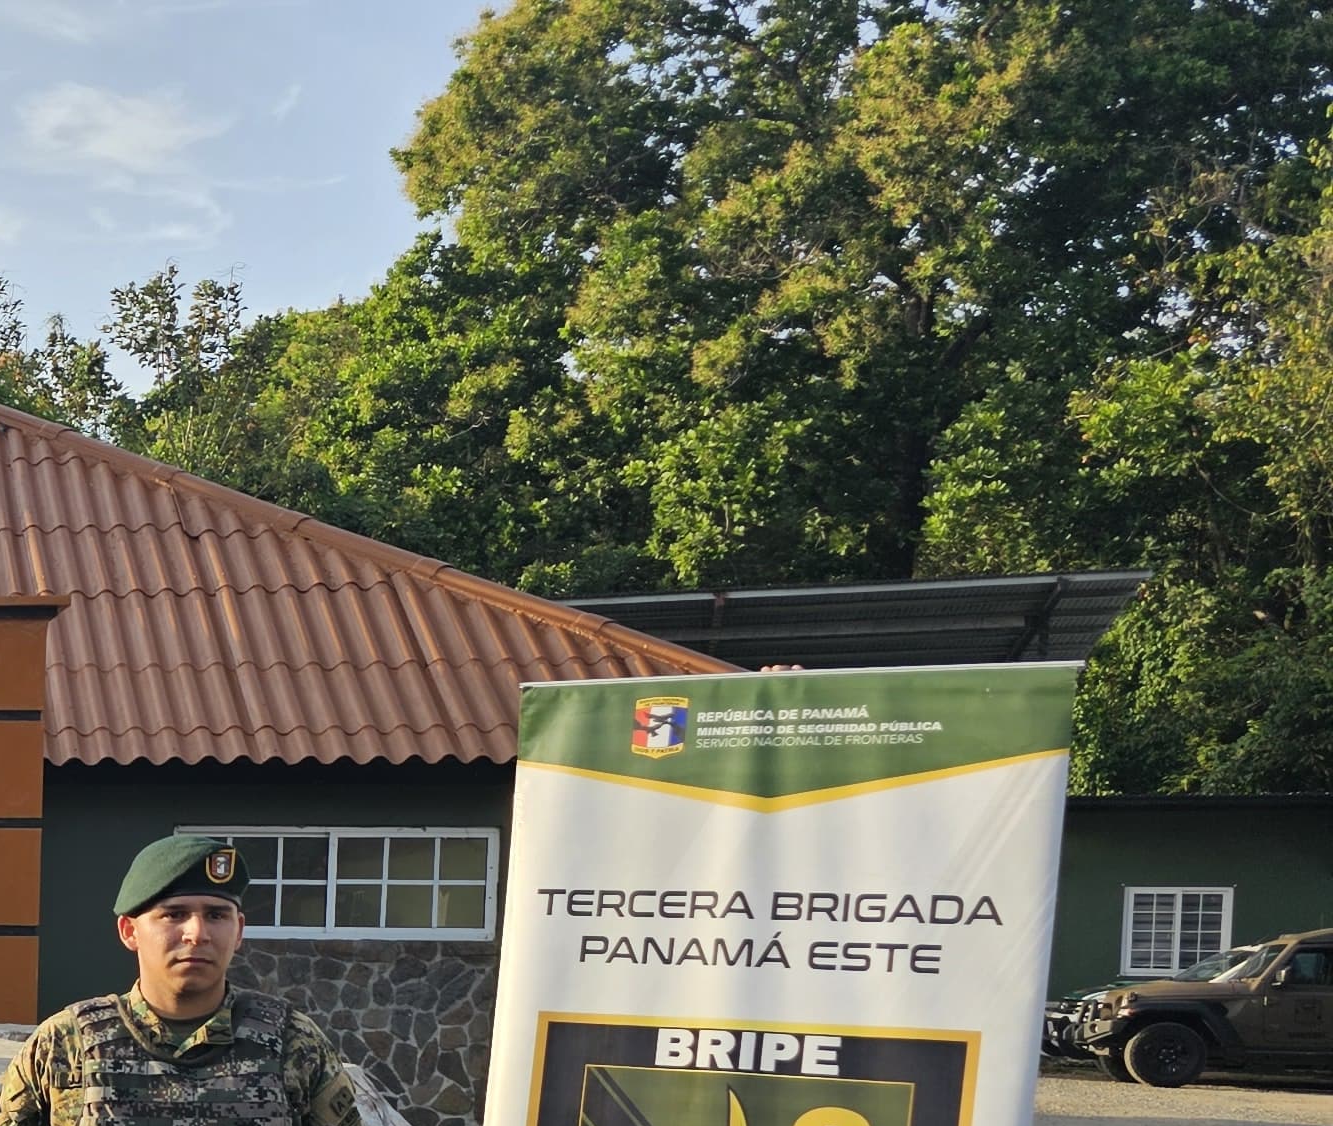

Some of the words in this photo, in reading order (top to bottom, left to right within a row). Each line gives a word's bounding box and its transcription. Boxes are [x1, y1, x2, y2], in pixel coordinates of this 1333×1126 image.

[697, 708, 774, 723] REPÚBLICA
[778, 709, 798, 721] DE
[801, 704, 869, 719] PANAMÁ
[696, 736, 751, 748] SERVICIO
[753, 735, 822, 747] NACIONAL
[824, 734, 842, 746] DE
[844, 733, 924, 745] FRONTERAS
[697, 725, 774, 737] MINISTERIO
[777, 724, 794, 735] DE
[798, 723, 877, 734] SEGURIDAD
[880, 719, 943, 732] PÚBLICA
[538, 888, 755, 920] TERCERA
[771, 892, 1004, 926] BRIGADA
[579, 931, 790, 969] PANAMÁ
[807, 941, 942, 975] ESTE
[654, 1028, 842, 1076] BRIPE
